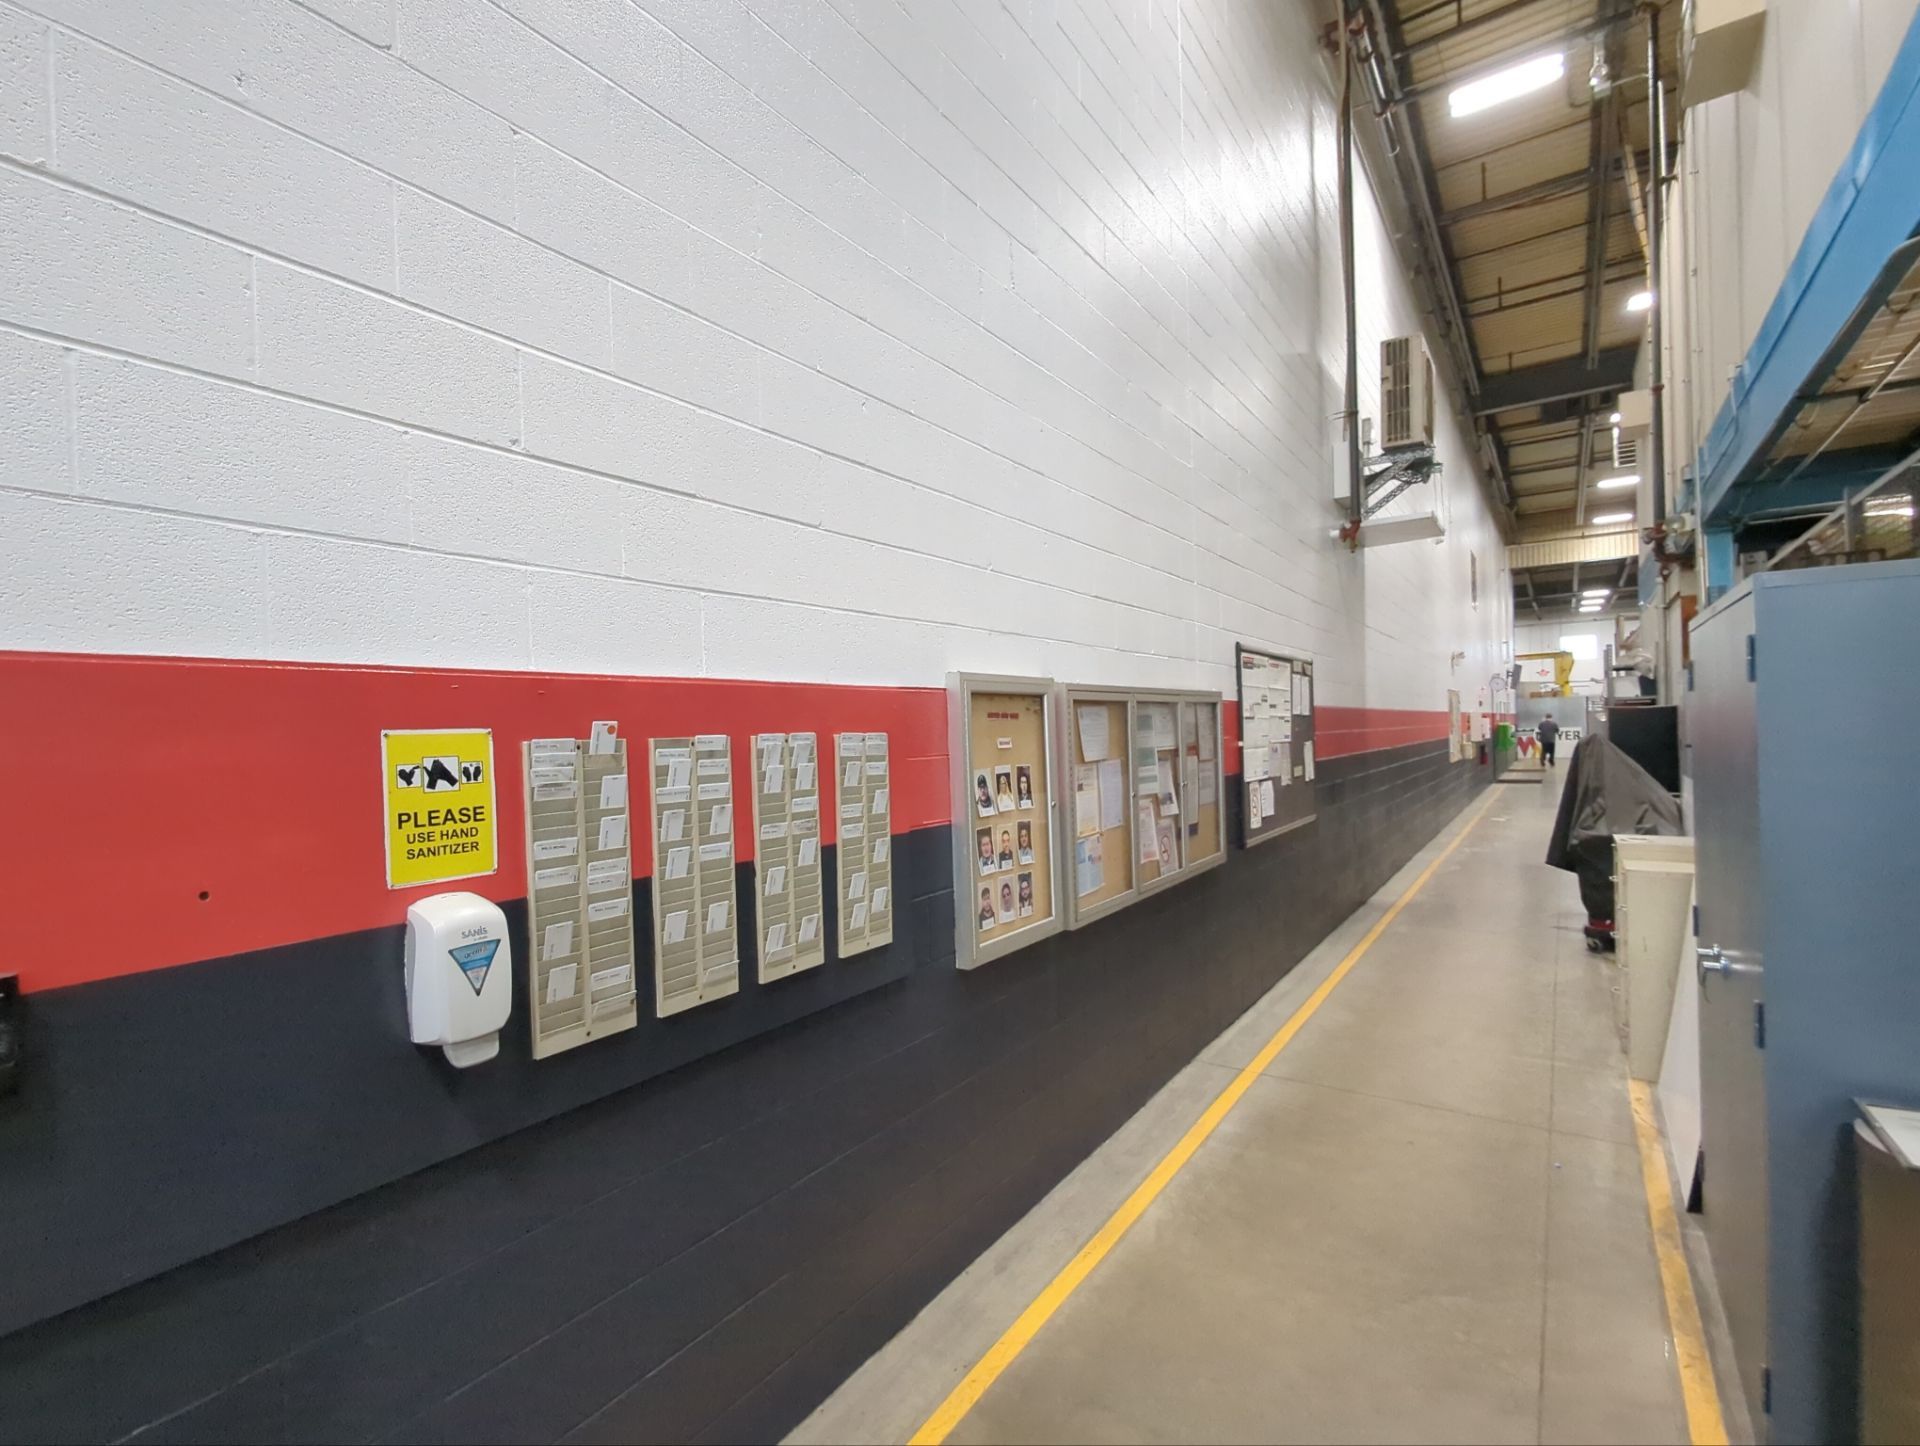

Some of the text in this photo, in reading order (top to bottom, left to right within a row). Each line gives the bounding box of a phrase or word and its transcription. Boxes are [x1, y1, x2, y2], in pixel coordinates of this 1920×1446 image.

[398, 806, 486, 830] PLEASE
[406, 827, 479, 844] USE HAND
[406, 841, 480, 860] SANITIZER
